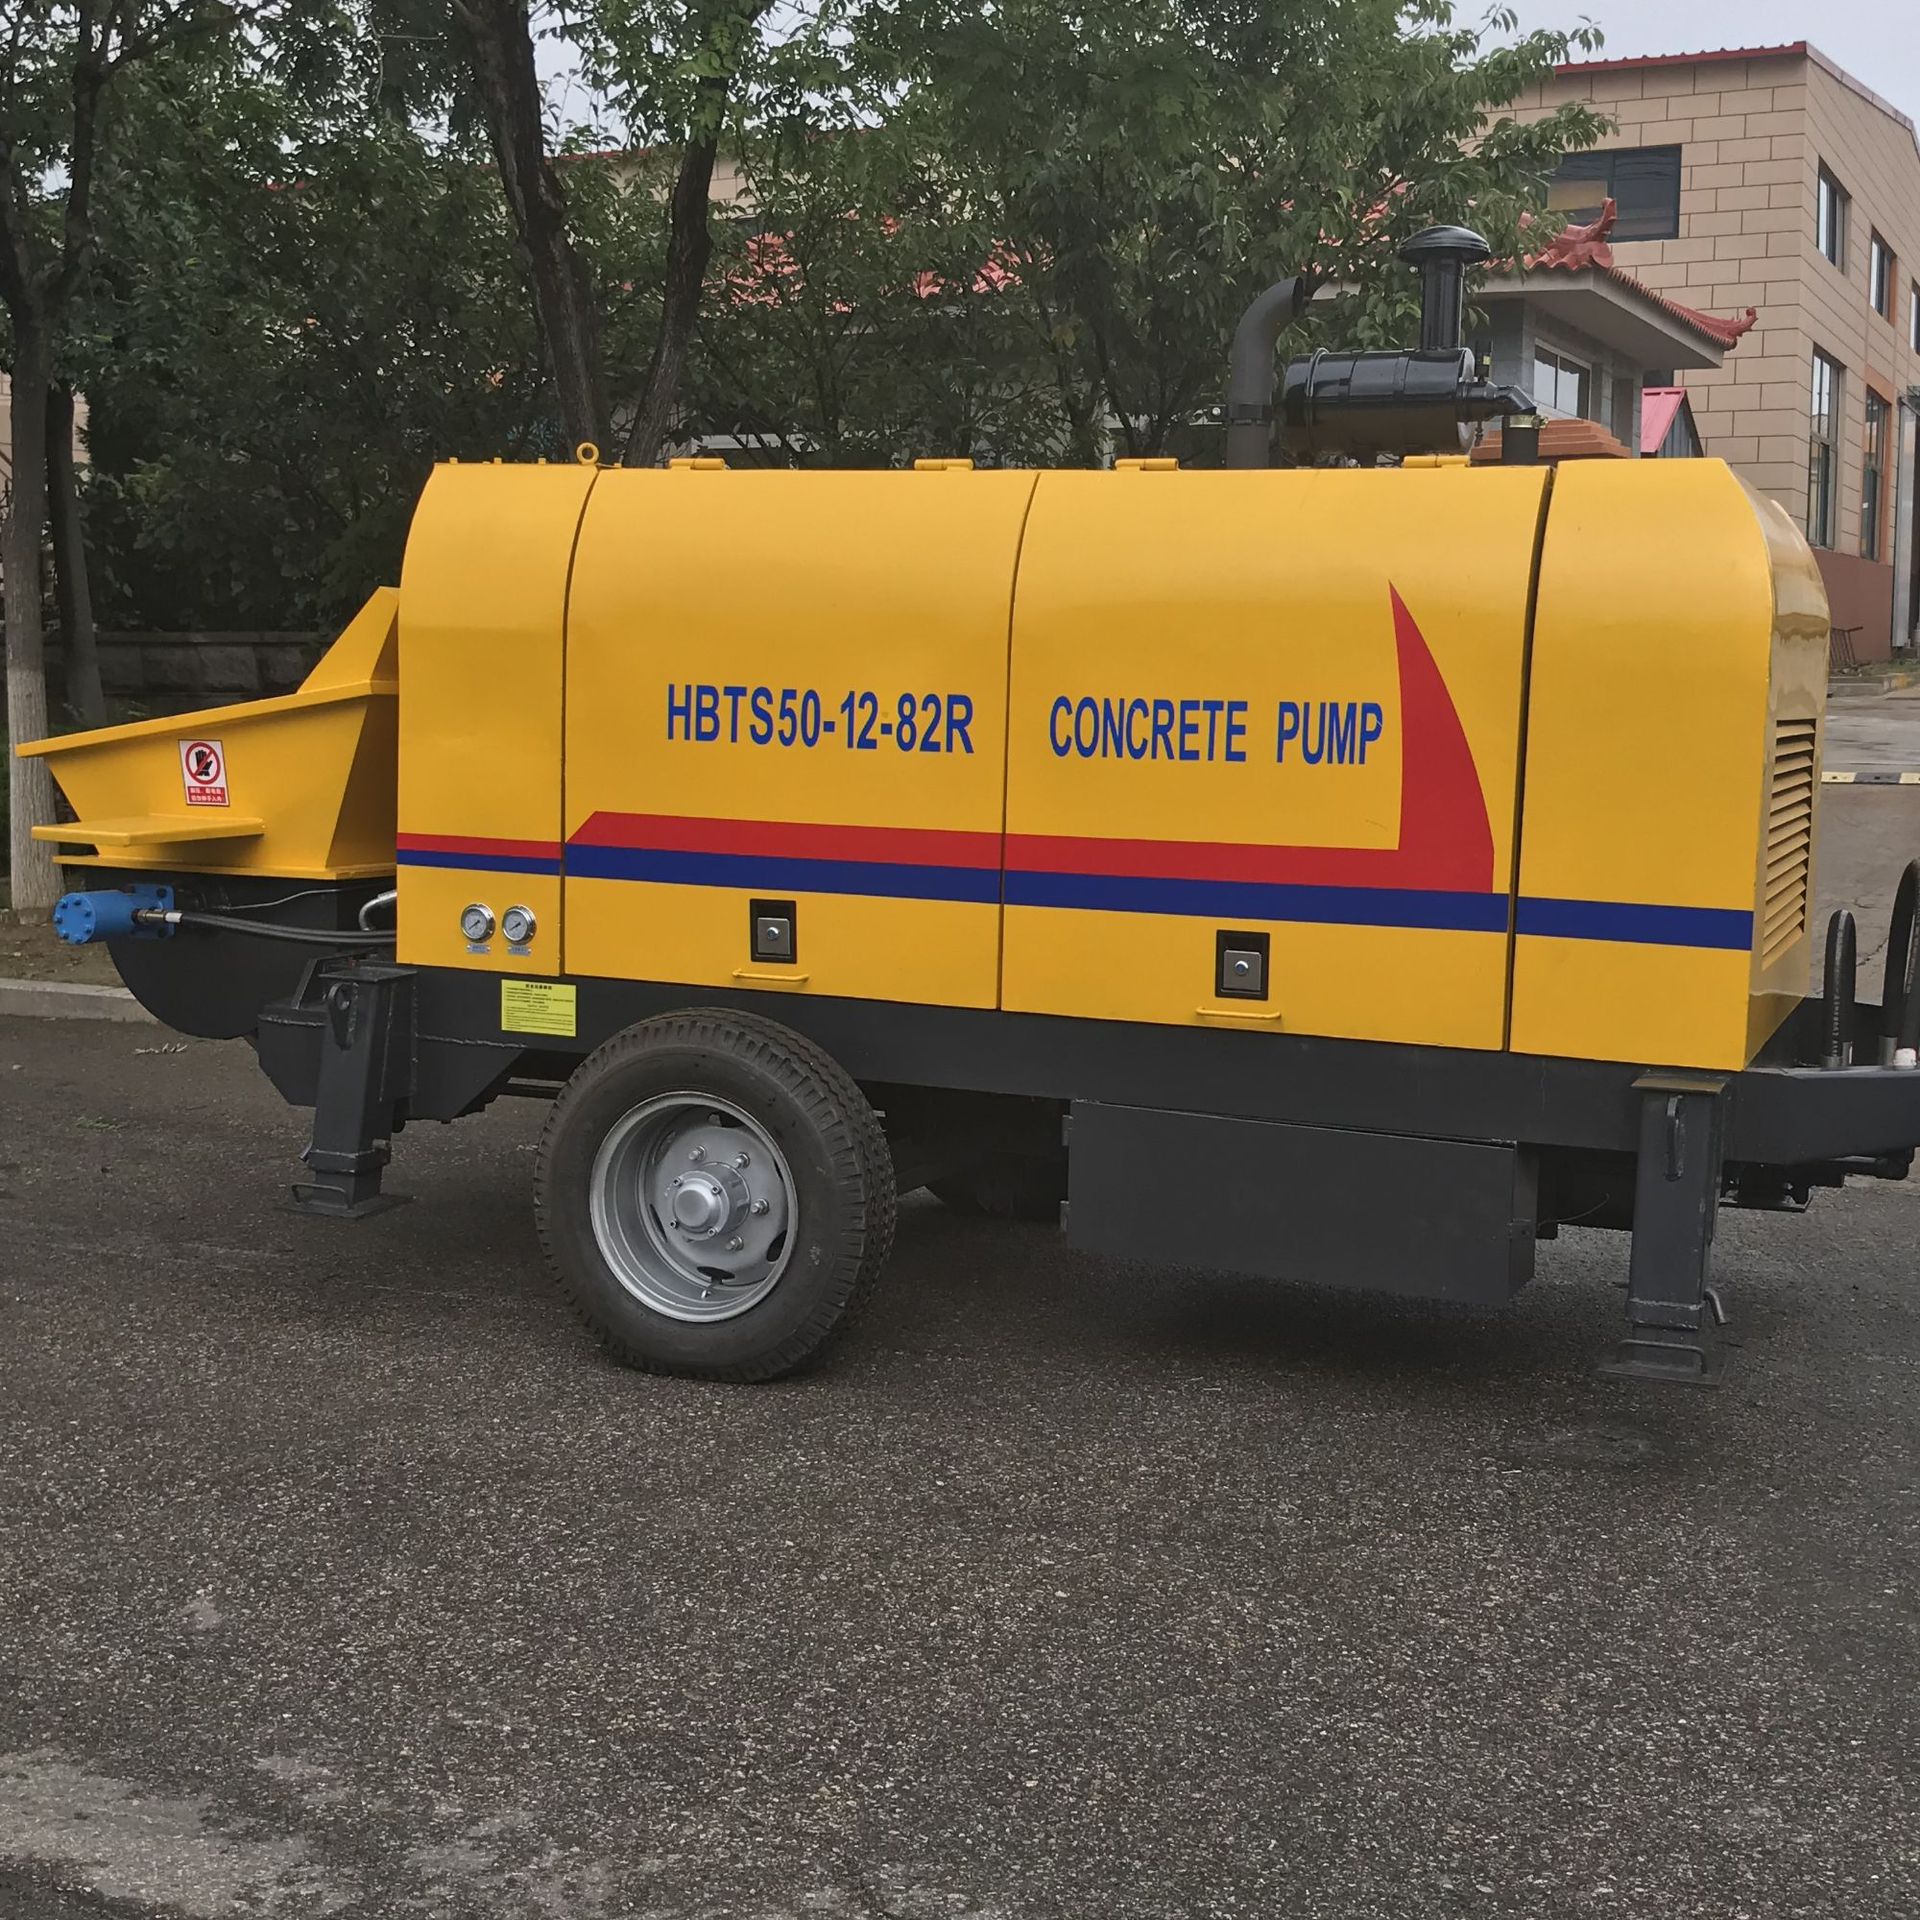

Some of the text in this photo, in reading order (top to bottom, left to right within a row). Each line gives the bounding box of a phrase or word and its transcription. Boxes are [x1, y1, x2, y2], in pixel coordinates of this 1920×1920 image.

[668, 685, 974, 754] HBTS50-12-82R
[1050, 696, 1383, 765] CONCRETE PUMP
